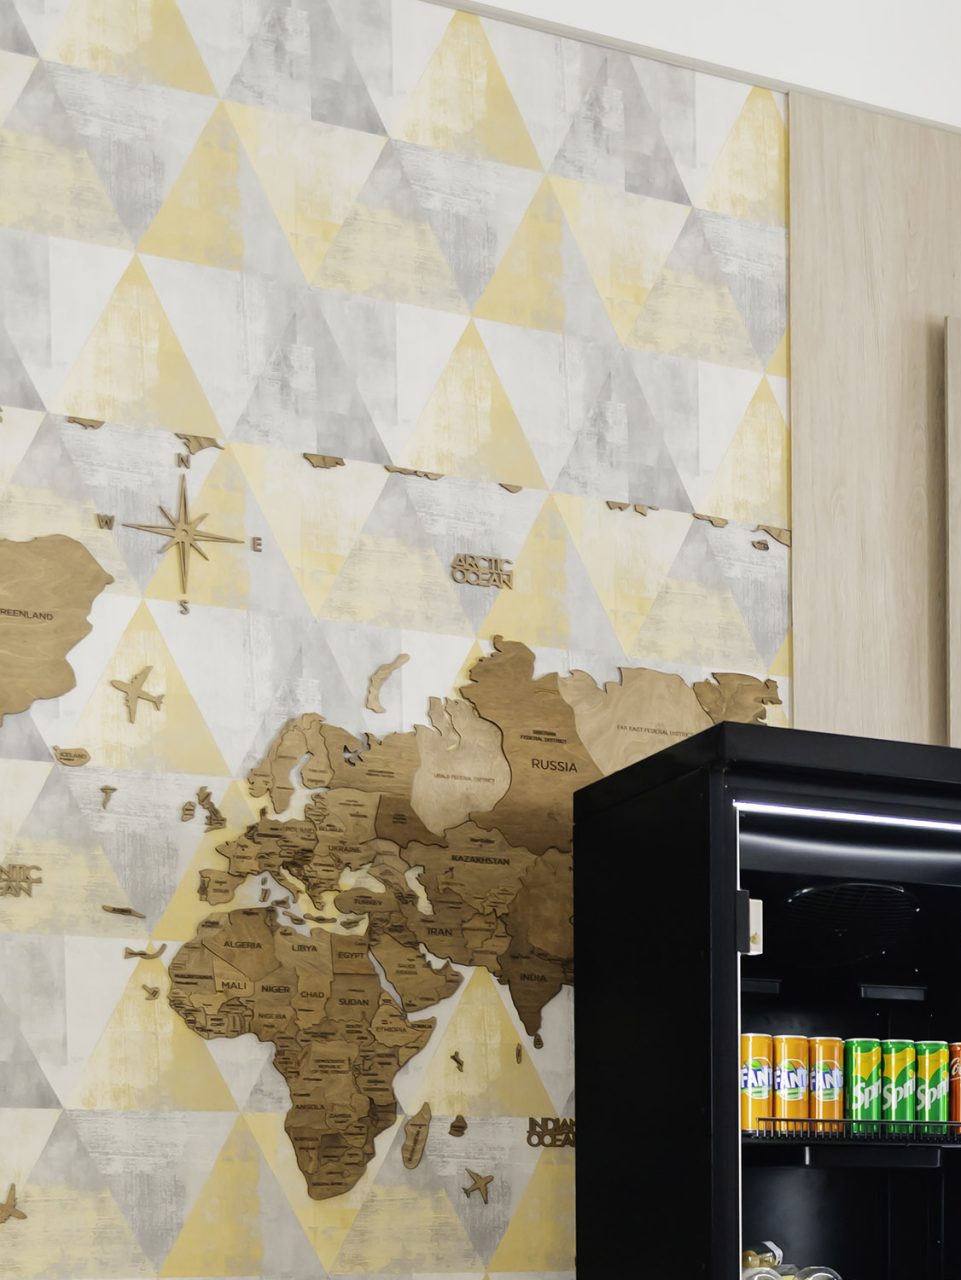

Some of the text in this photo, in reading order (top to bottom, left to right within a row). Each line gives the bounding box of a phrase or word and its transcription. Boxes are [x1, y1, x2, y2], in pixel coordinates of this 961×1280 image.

[177, 453, 191, 469] N
[96, 513, 115, 531] W
[252, 537, 263, 552] E
[451, 553, 514, 572] ARCTIC
[451, 569, 513, 590] OCEAN
[179, 600, 190, 615] S
[0, 608, 54, 621] REENLAND
[531, 758, 578, 773] RUSSIA
[451, 854, 511, 866] KAZAKHSTAN
[427, 927, 453, 937] IRAN
[223, 941, 263, 950] ALGERIA
[291, 944, 319, 953] LIBYA
[337, 951, 365, 960] EGYPT
[519, 972, 548, 983] INDIA
[221, 981, 248, 990] MALI
[261, 985, 292, 994] NIGER
[300, 991, 325, 999] CHAD
[338, 998, 369, 1007] SUDAN
[526, 1131, 576, 1148] OCEA
